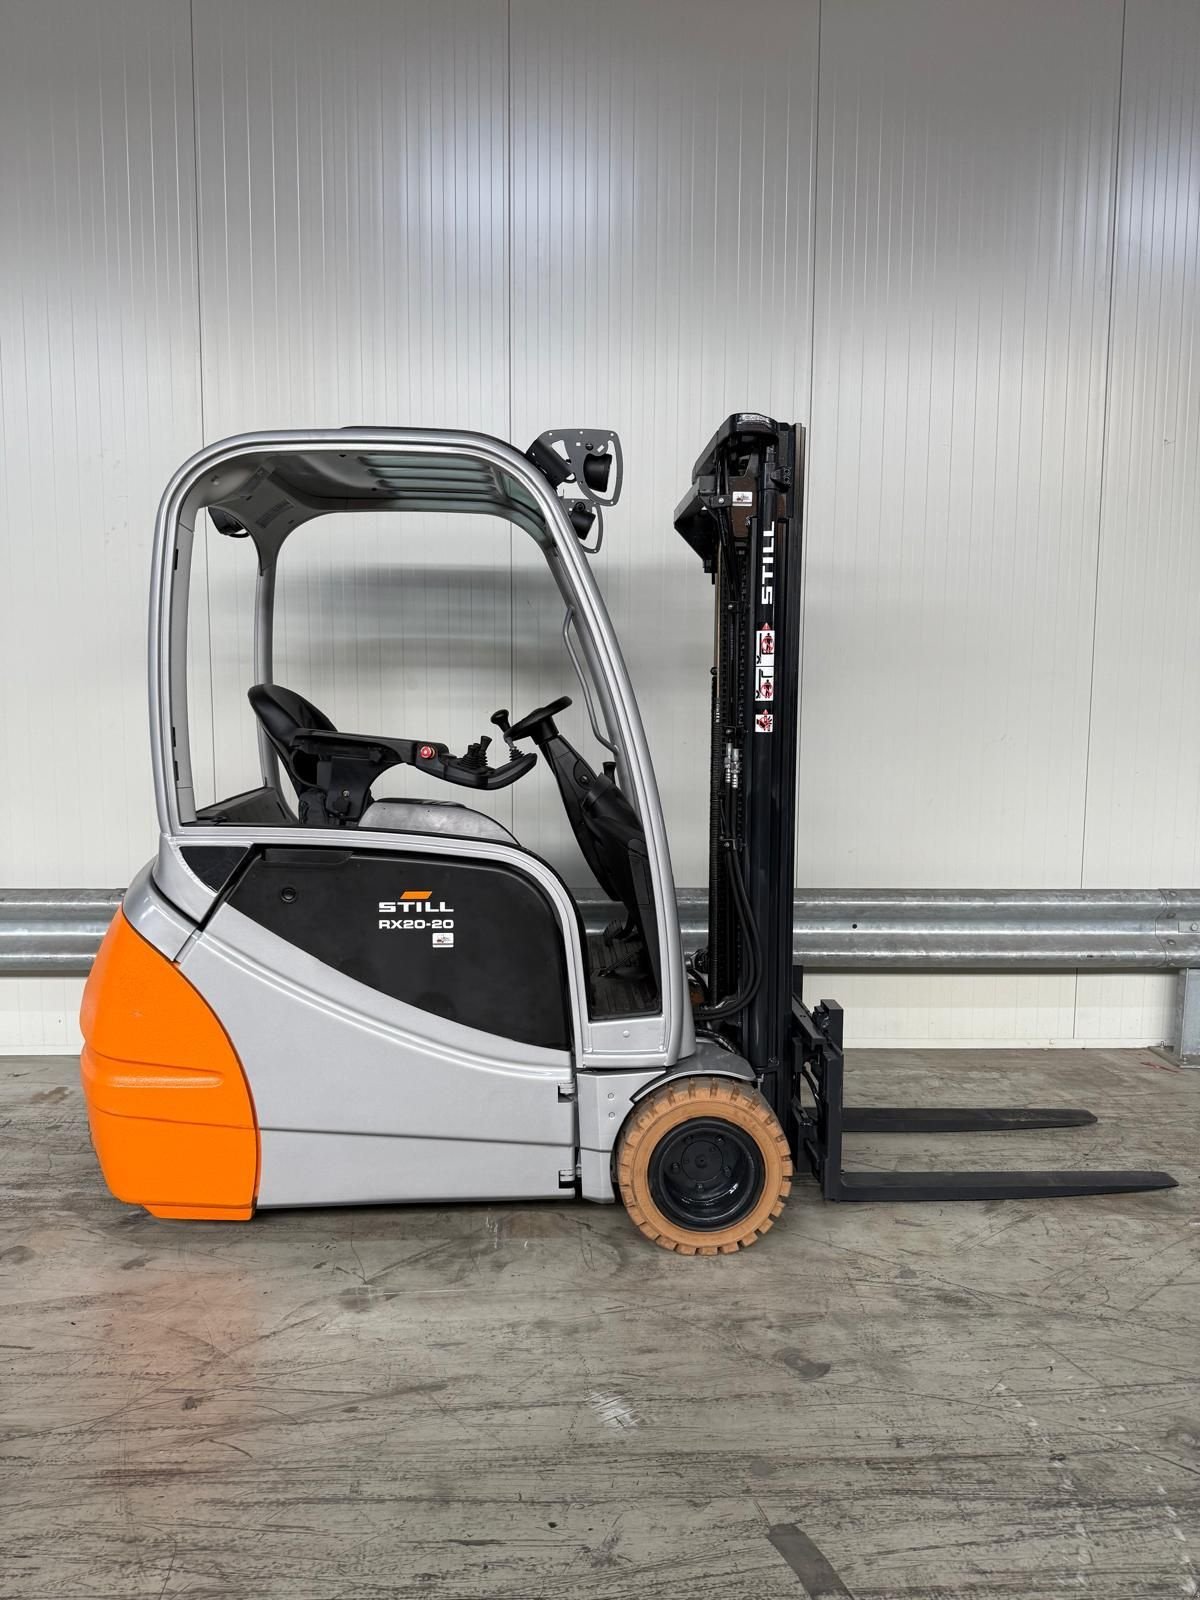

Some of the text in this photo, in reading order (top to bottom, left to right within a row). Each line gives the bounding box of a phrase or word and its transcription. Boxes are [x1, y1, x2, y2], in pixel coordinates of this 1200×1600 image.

[761, 521, 775, 604] STILL
[378, 902, 454, 912] STILL
[378, 920, 454, 929] RX20-20
